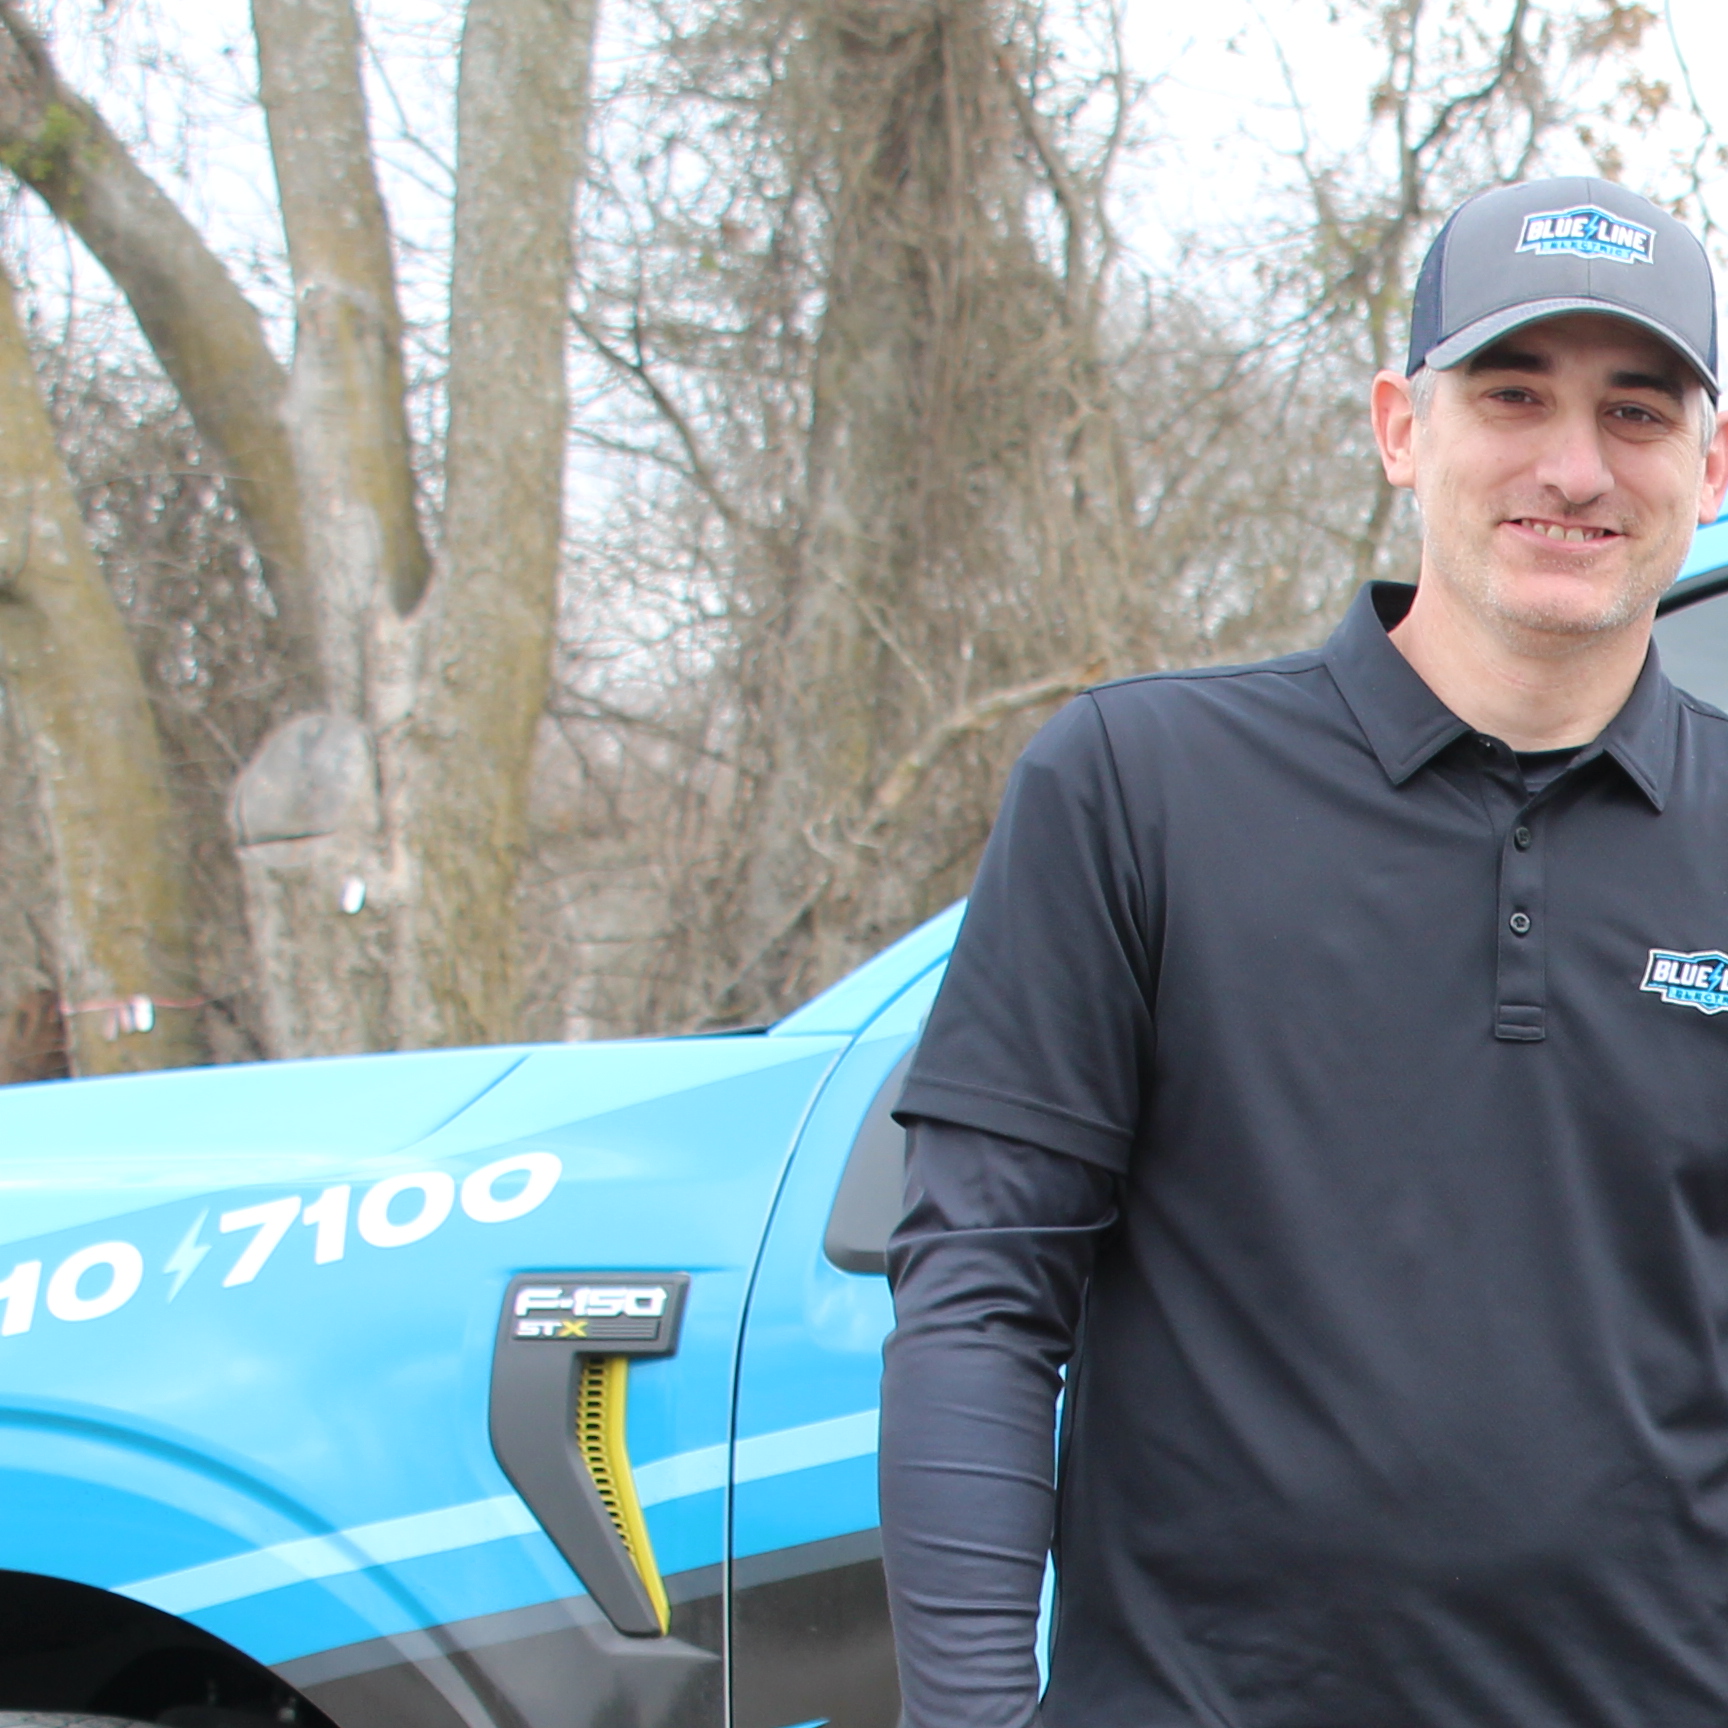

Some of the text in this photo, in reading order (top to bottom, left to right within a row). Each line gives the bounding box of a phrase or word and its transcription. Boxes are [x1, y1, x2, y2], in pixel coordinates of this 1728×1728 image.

[1528, 219, 1647, 250] BLUE LINE
[1653, 960, 1713, 987] BLUE
[220, 1151, 563, 1288] 7100
[515, 1287, 667, 1317] F-150
[516, 1321, 588, 1337] STX
